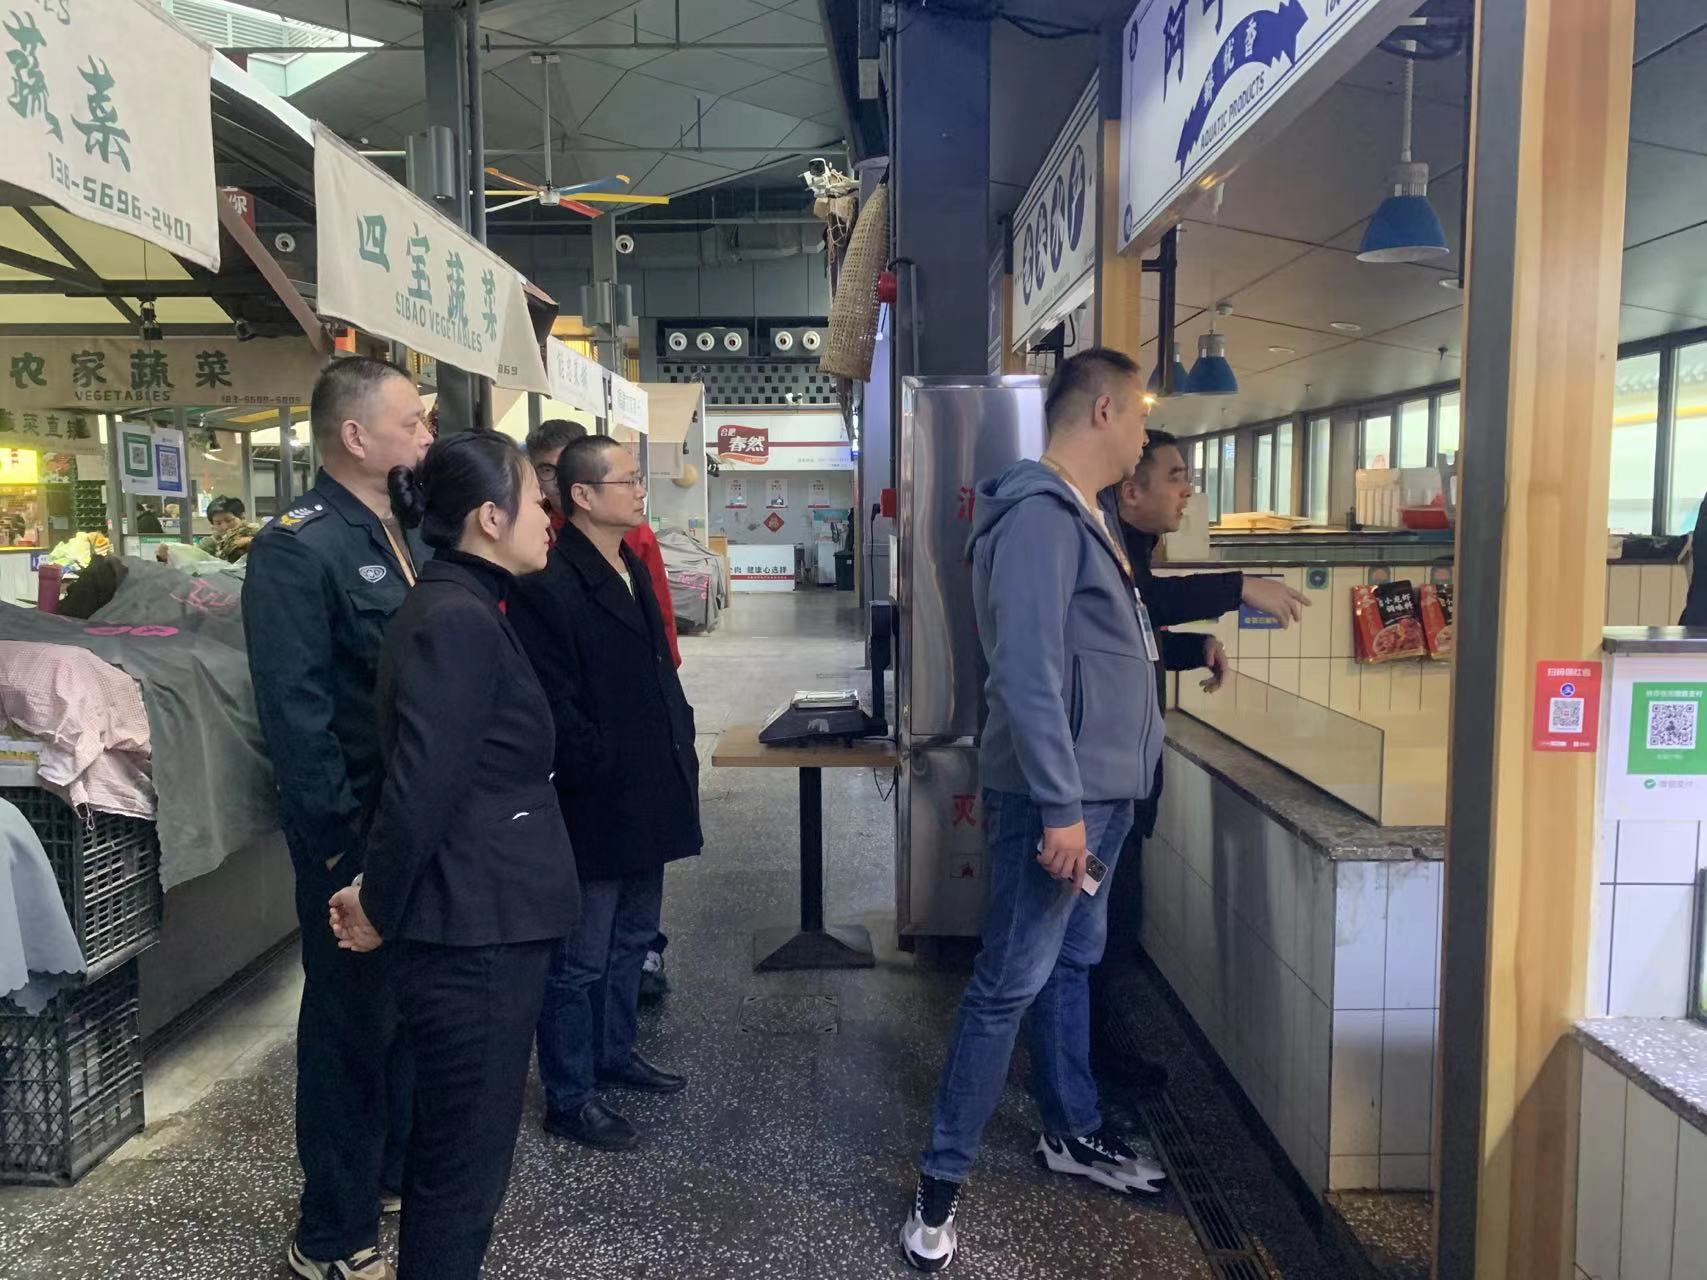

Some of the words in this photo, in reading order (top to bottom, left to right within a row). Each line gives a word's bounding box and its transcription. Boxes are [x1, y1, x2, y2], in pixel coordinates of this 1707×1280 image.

[1200, 110, 1227, 150] AQUATIC
[1228, 71, 1265, 123] PRODUCTS
[356, 211, 498, 342] 四宝蔬菜
[396, 291, 426, 328] SIBAO
[429, 310, 483, 353] VEGETABLES
[10, 349, 233, 391] 农家蔬菜
[74, 390, 171, 401] VEGETABLES
[720, 428, 736, 437] 合肥
[728, 436, 765, 452] 春然
